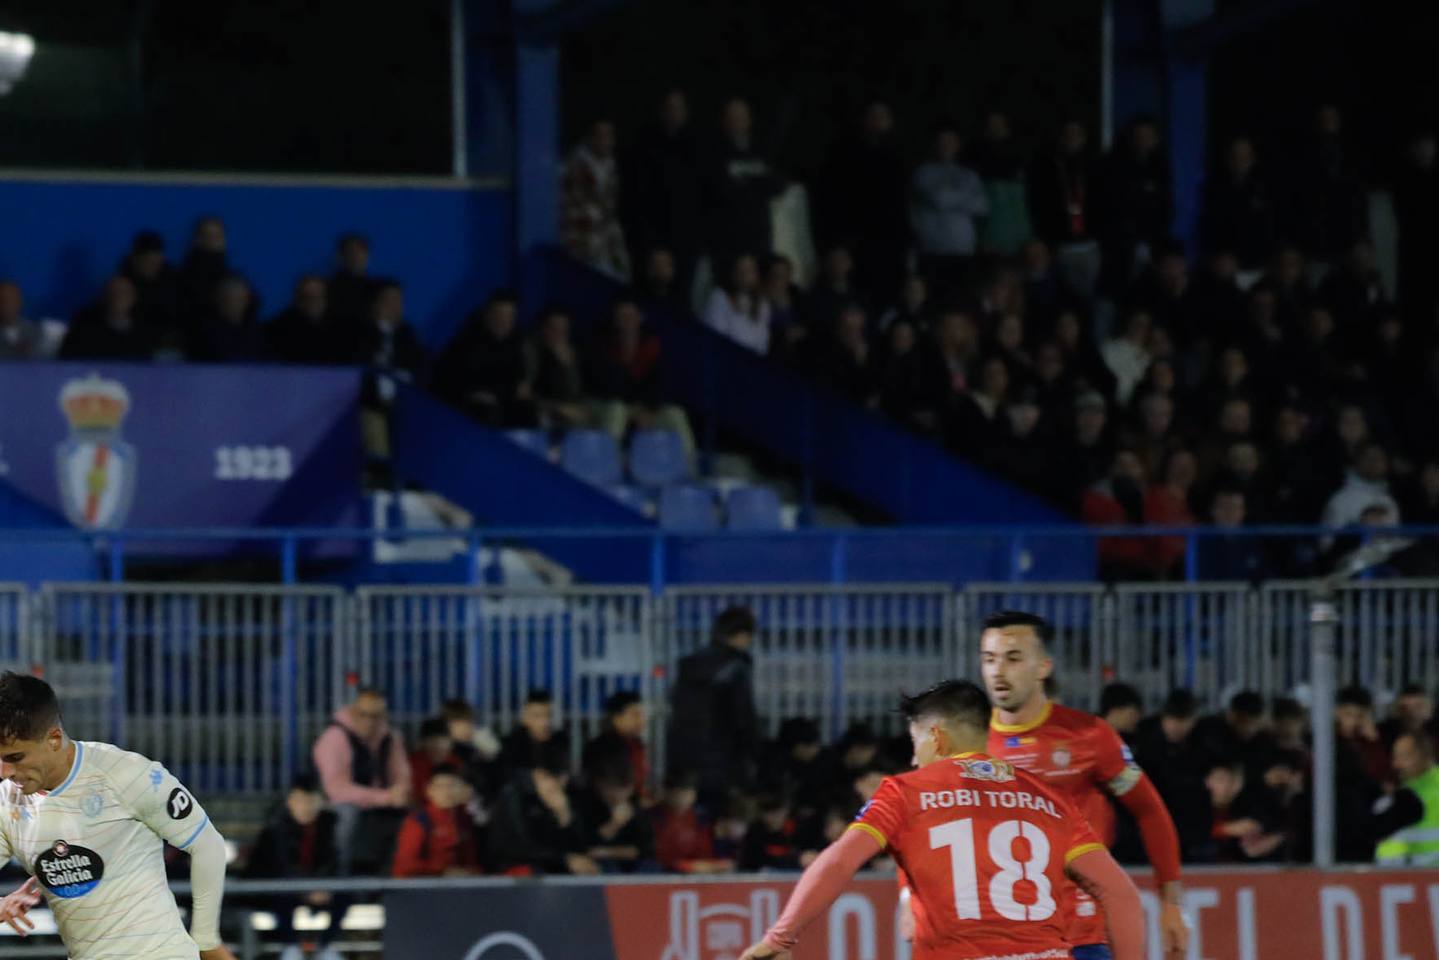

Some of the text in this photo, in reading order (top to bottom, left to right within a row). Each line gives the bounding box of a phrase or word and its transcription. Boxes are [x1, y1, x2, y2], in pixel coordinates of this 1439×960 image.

[215, 445, 293, 481] 1923
[919, 788, 1062, 819] ROBI TORAL
[40, 854, 92, 873] Estrella
[46, 867, 94, 886] Galicia
[928, 817, 1057, 922] 18
